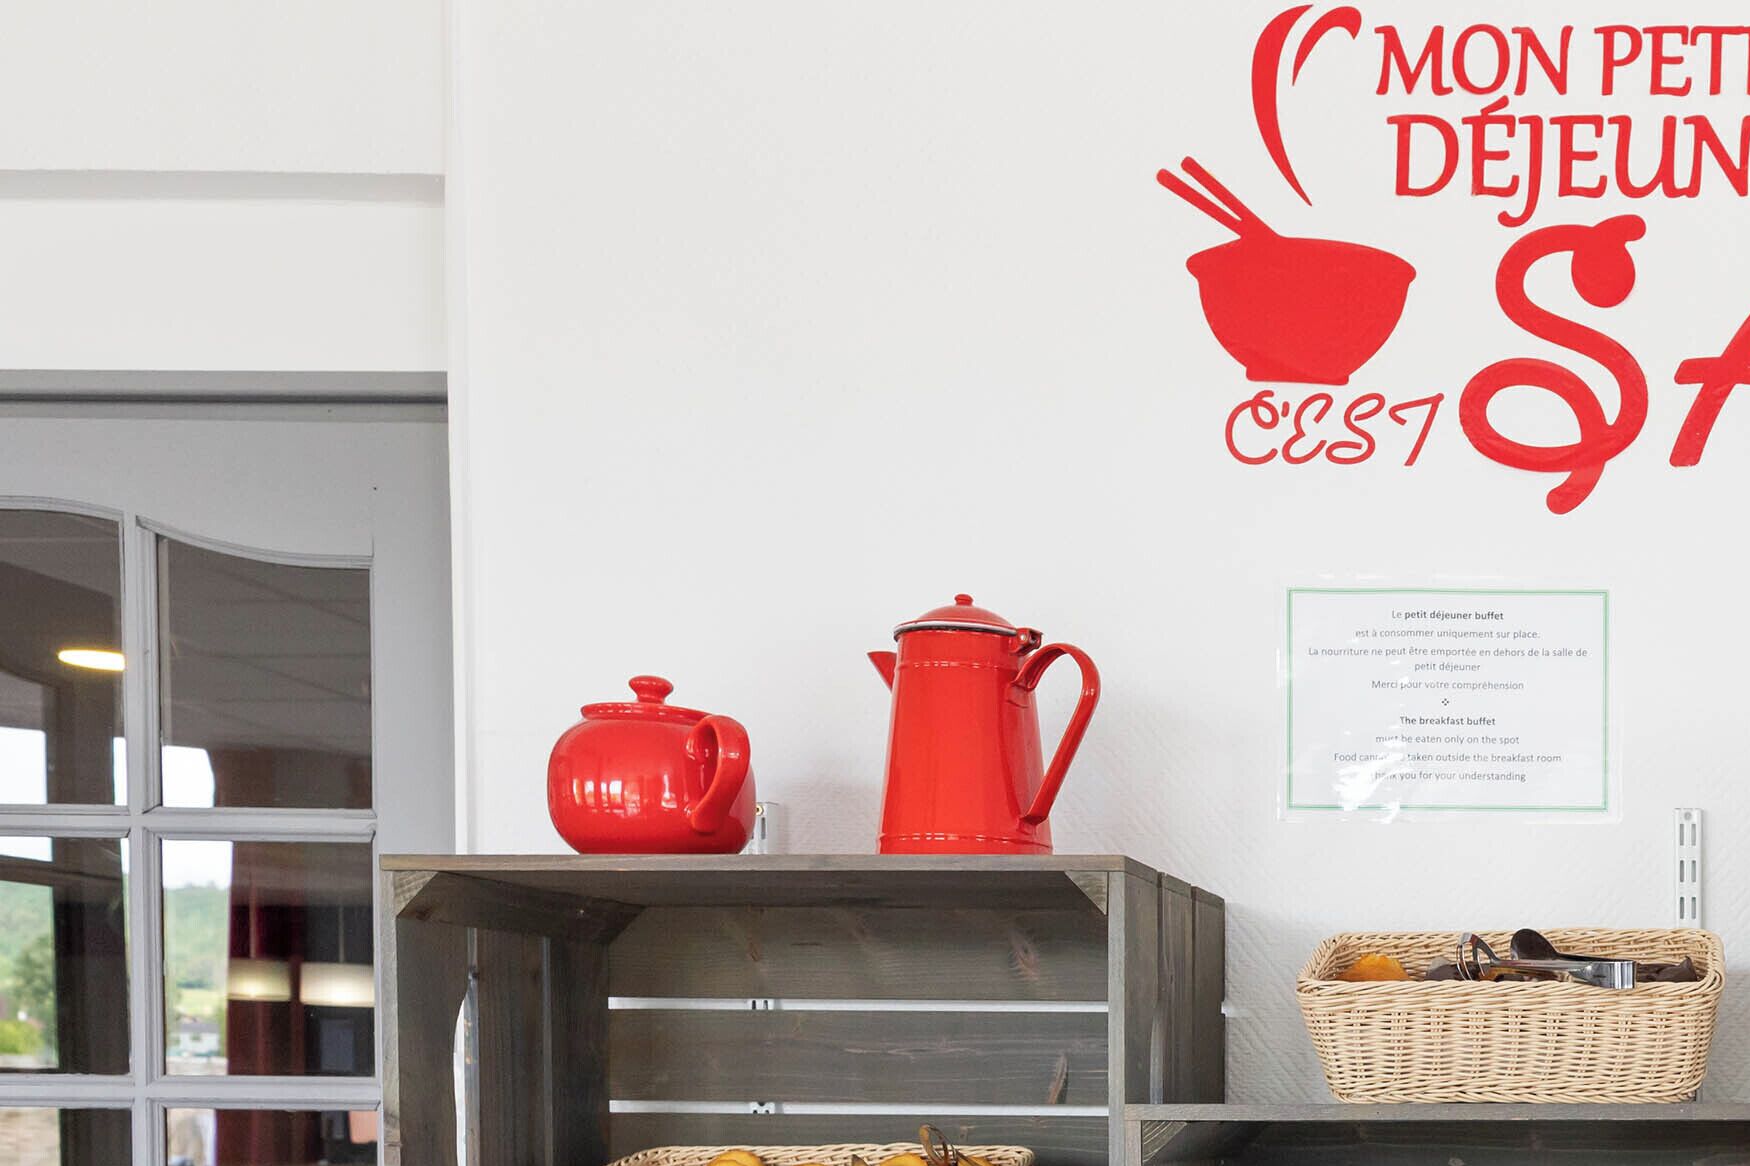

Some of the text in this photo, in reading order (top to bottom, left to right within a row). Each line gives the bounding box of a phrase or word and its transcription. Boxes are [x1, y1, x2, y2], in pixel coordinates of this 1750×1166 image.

[1374, 24, 1573, 96] MON
[1226, 390, 1444, 466] C'EST
[1391, 609, 1504, 622] Le petit déjeuner buffet
[1354, 629, 1370, 638] est
[1379, 629, 1434, 638] consommer
[1436, 628, 1494, 640] uniquement
[1495, 629, 1511, 639] sur
[1308, 646, 1588, 660] La nourriture ne peut être emportée en dehors de la salle de
[1414, 661, 1481, 674] petit déjeuner
[1371, 679, 1525, 692] Merci pour votre compréhension
[1399, 715, 1496, 727] The breakfast buffet
[1400, 734, 1413, 744] be
[1415, 735, 1442, 745] eaten
[1444, 734, 1465, 746] only
[1466, 735, 1479, 745] on
[1481, 735, 1497, 745] the
[1499, 735, 1520, 747] spot
[1333, 752, 1357, 762] Food
[1407, 752, 1434, 762] taken
[1435, 752, 1471, 762] outside
[1472, 753, 1489, 762] the
[1490, 752, 1535, 763] breakfast
[1536, 754, 1562, 763] room
[1399, 772, 1417, 783] you
[1419, 771, 1433, 780] for
[1434, 772, 1457, 783] your
[1458, 771, 1526, 784] understanding
